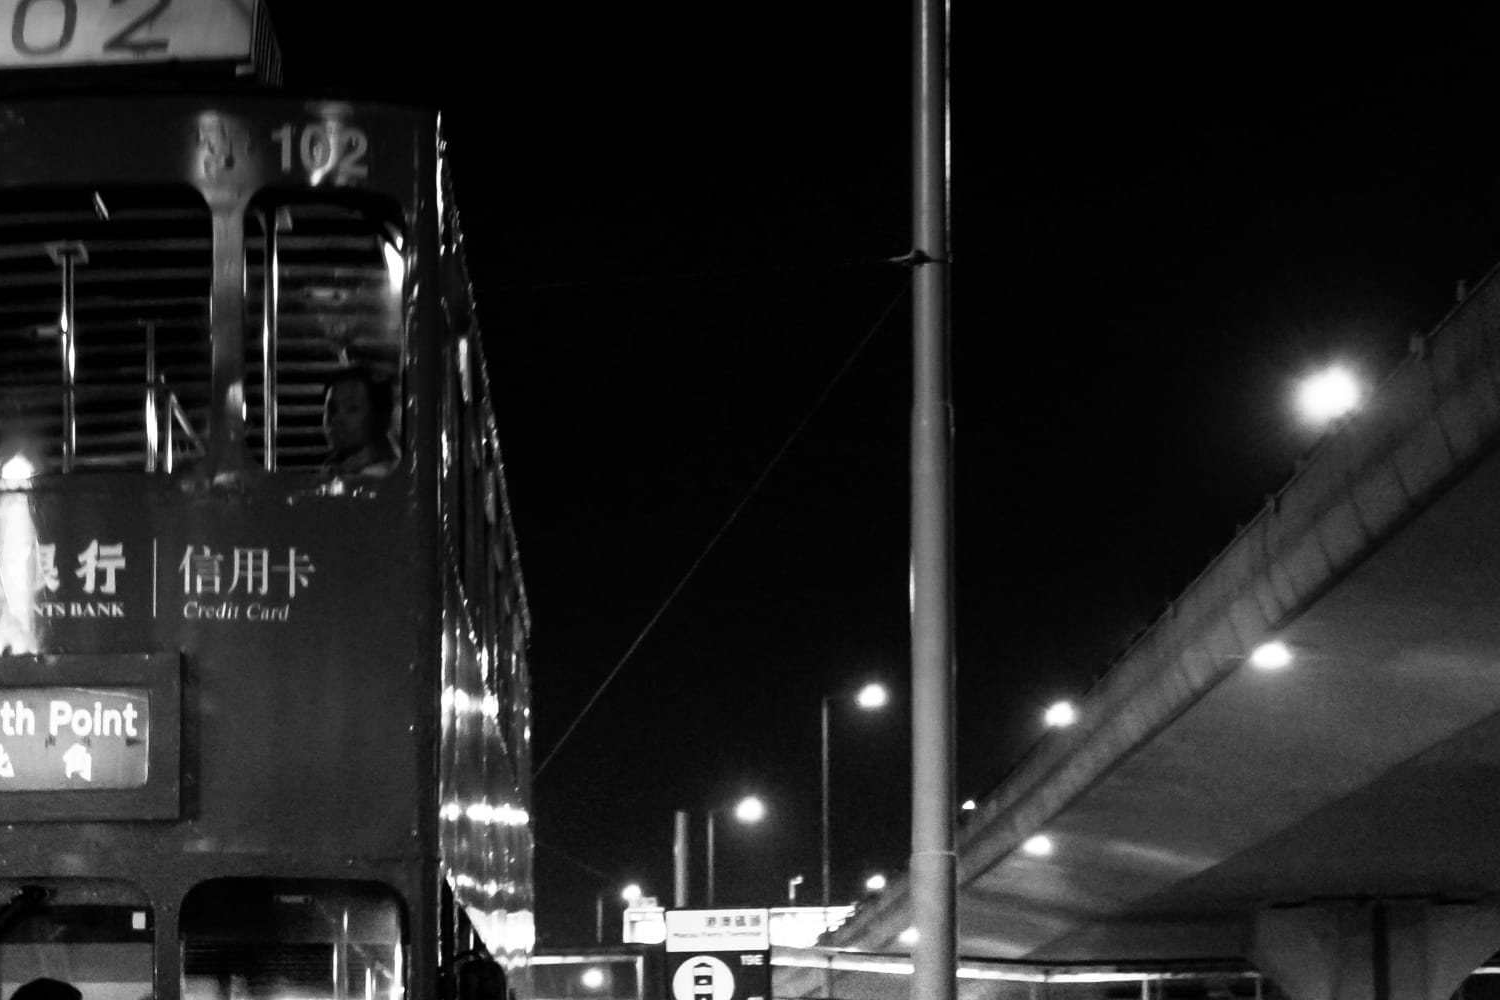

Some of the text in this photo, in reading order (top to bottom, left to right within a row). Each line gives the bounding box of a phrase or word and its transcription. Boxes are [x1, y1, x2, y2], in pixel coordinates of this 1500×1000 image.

[269, 122, 369, 187] 102
[178, 544, 316, 599] 信用卡
[70, 601, 125, 618] BANK
[183, 601, 291, 622] Credit Card
[49, 700, 138, 737] Point
